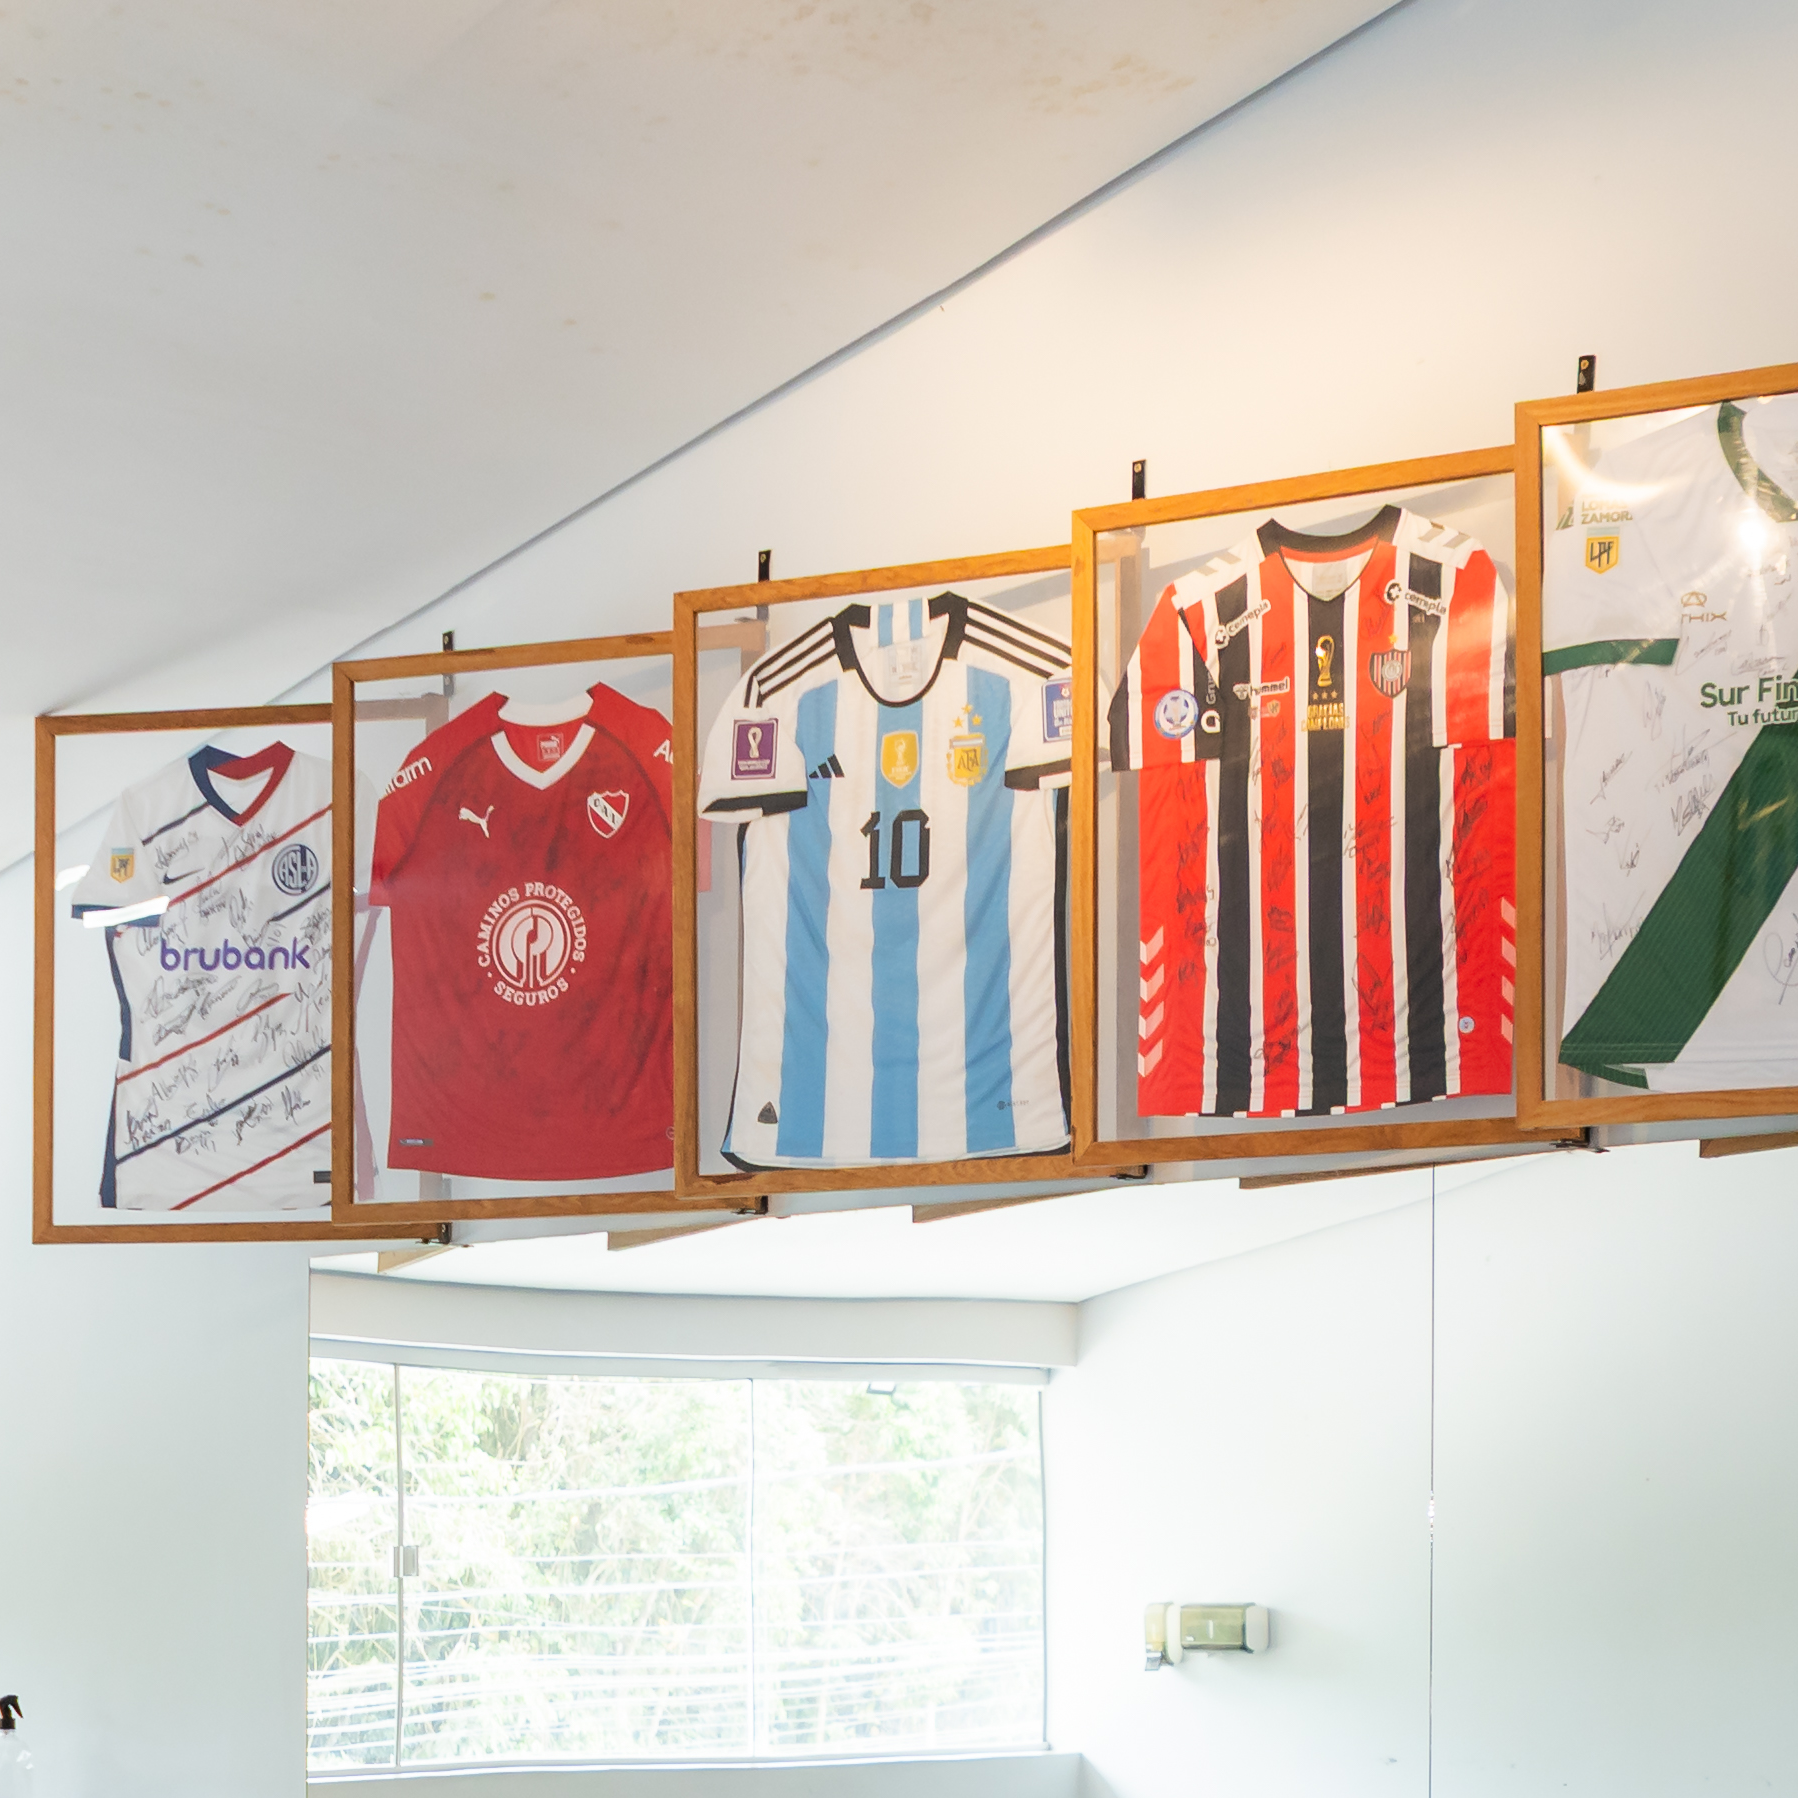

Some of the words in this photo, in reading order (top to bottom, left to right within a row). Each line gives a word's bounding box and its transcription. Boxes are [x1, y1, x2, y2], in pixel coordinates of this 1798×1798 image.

[1700, 682, 1750, 708] Sur
[1727, 711, 1749, 727] Tu
[859, 808, 931, 890] 10
[477, 887, 520, 967] CAMINOS
[524, 881, 587, 962] PROTEGIDOS
[160, 936, 311, 971] brubank
[493, 977, 569, 1006] SEGUROS
